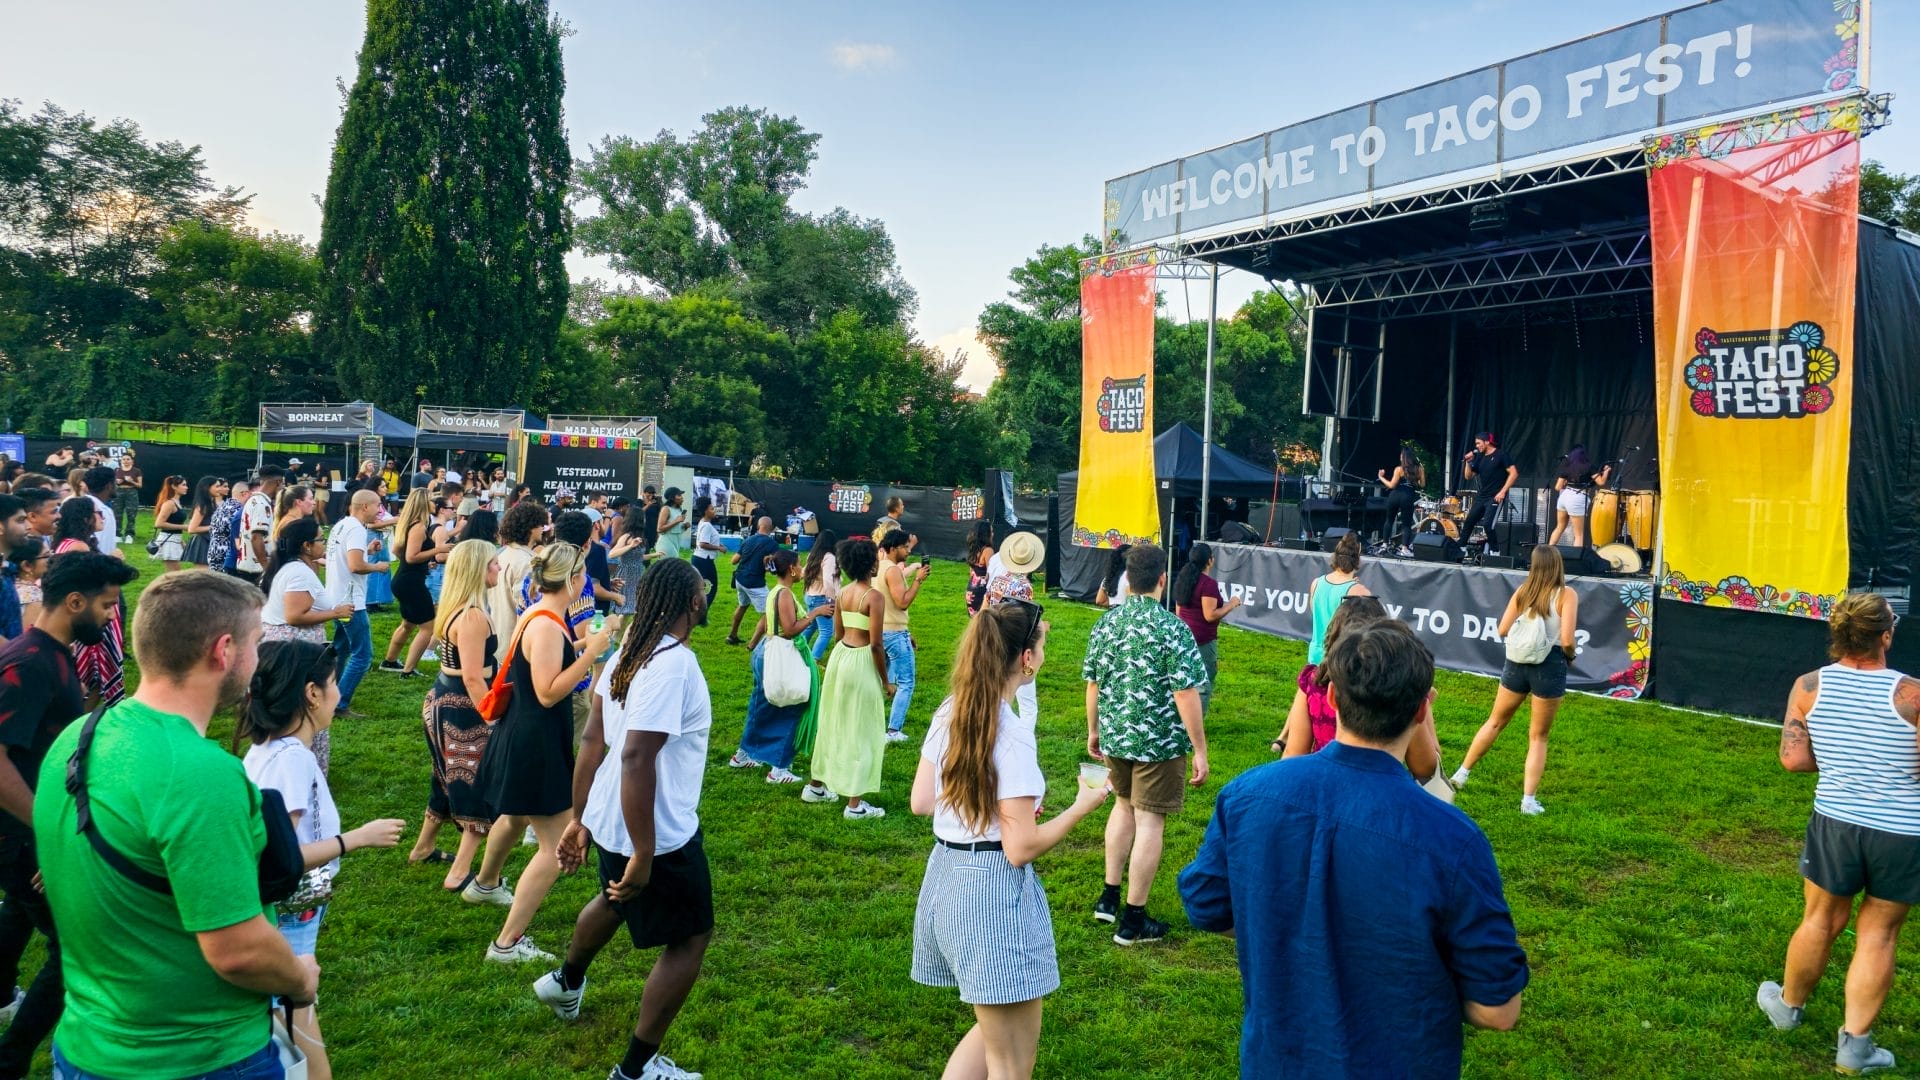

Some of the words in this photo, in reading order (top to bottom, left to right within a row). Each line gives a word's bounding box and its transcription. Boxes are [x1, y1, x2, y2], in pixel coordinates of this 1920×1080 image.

[1141, 145, 1315, 222] WELCOME
[1330, 126, 1387, 175] TO
[1405, 84, 1542, 156] TACO
[1565, 24, 1754, 119] FEST!
[1709, 344, 1806, 381] TACO
[1109, 387, 1145, 410] TACO
[1715, 379, 1805, 414] FEST
[288, 413, 344, 422] BORN2EAT
[440, 416, 470, 427] KO'OX
[472, 418, 500, 428] HANA
[1109, 408, 1144, 430] FEST
[565, 426, 587, 435] MAD
[590, 426, 637, 437] MEXICAN
[556, 467, 610, 477] YESTERDAY
[612, 468, 616, 478] I
[543, 480, 582, 490] REALLY
[584, 481, 624, 491] WANTED
[837, 489, 865, 501] TACO
[957, 494, 978, 507] TACO
[836, 500, 864, 513] FEST
[957, 506, 978, 520] FEST
[1265, 588, 1309, 614] YOU
[1412, 607, 1451, 635] TO
